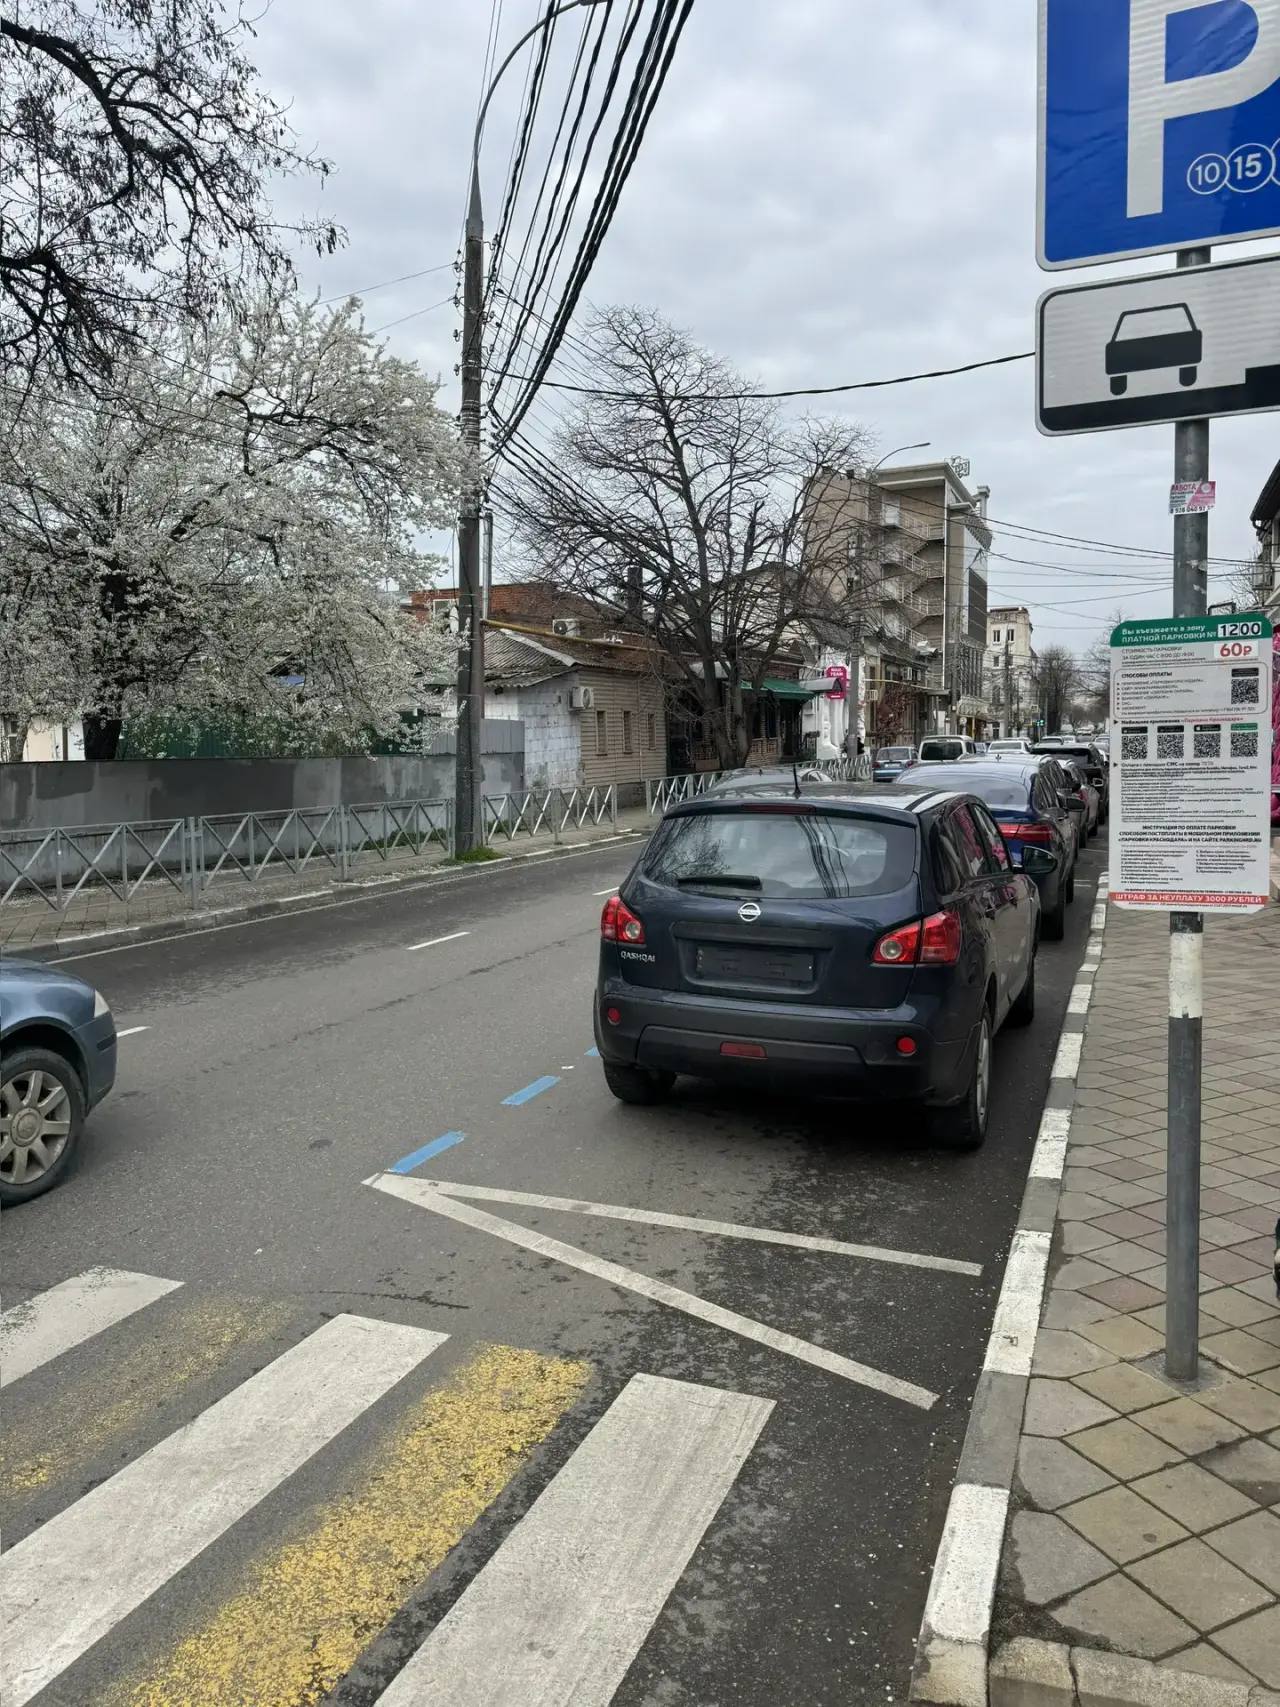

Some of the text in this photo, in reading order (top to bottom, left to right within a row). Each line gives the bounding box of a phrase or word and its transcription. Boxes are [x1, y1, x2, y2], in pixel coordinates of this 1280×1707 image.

[1127, 0, 1280, 218] P
[1195, 152, 1261, 185] 10 15
[1136, 626, 1178, 634] въезжаете
[1220, 622, 1261, 636] 1200
[1121, 633, 1160, 643] ПЛАТНОЙ
[1161, 631, 1206, 641] ПАРКОВКИ
[1159, 894, 1204, 902] НЕУПЛАТУ
[1228, 895, 1262, 903] РУБЛЕЙ
[620, 950, 656, 962] QASHQAI
